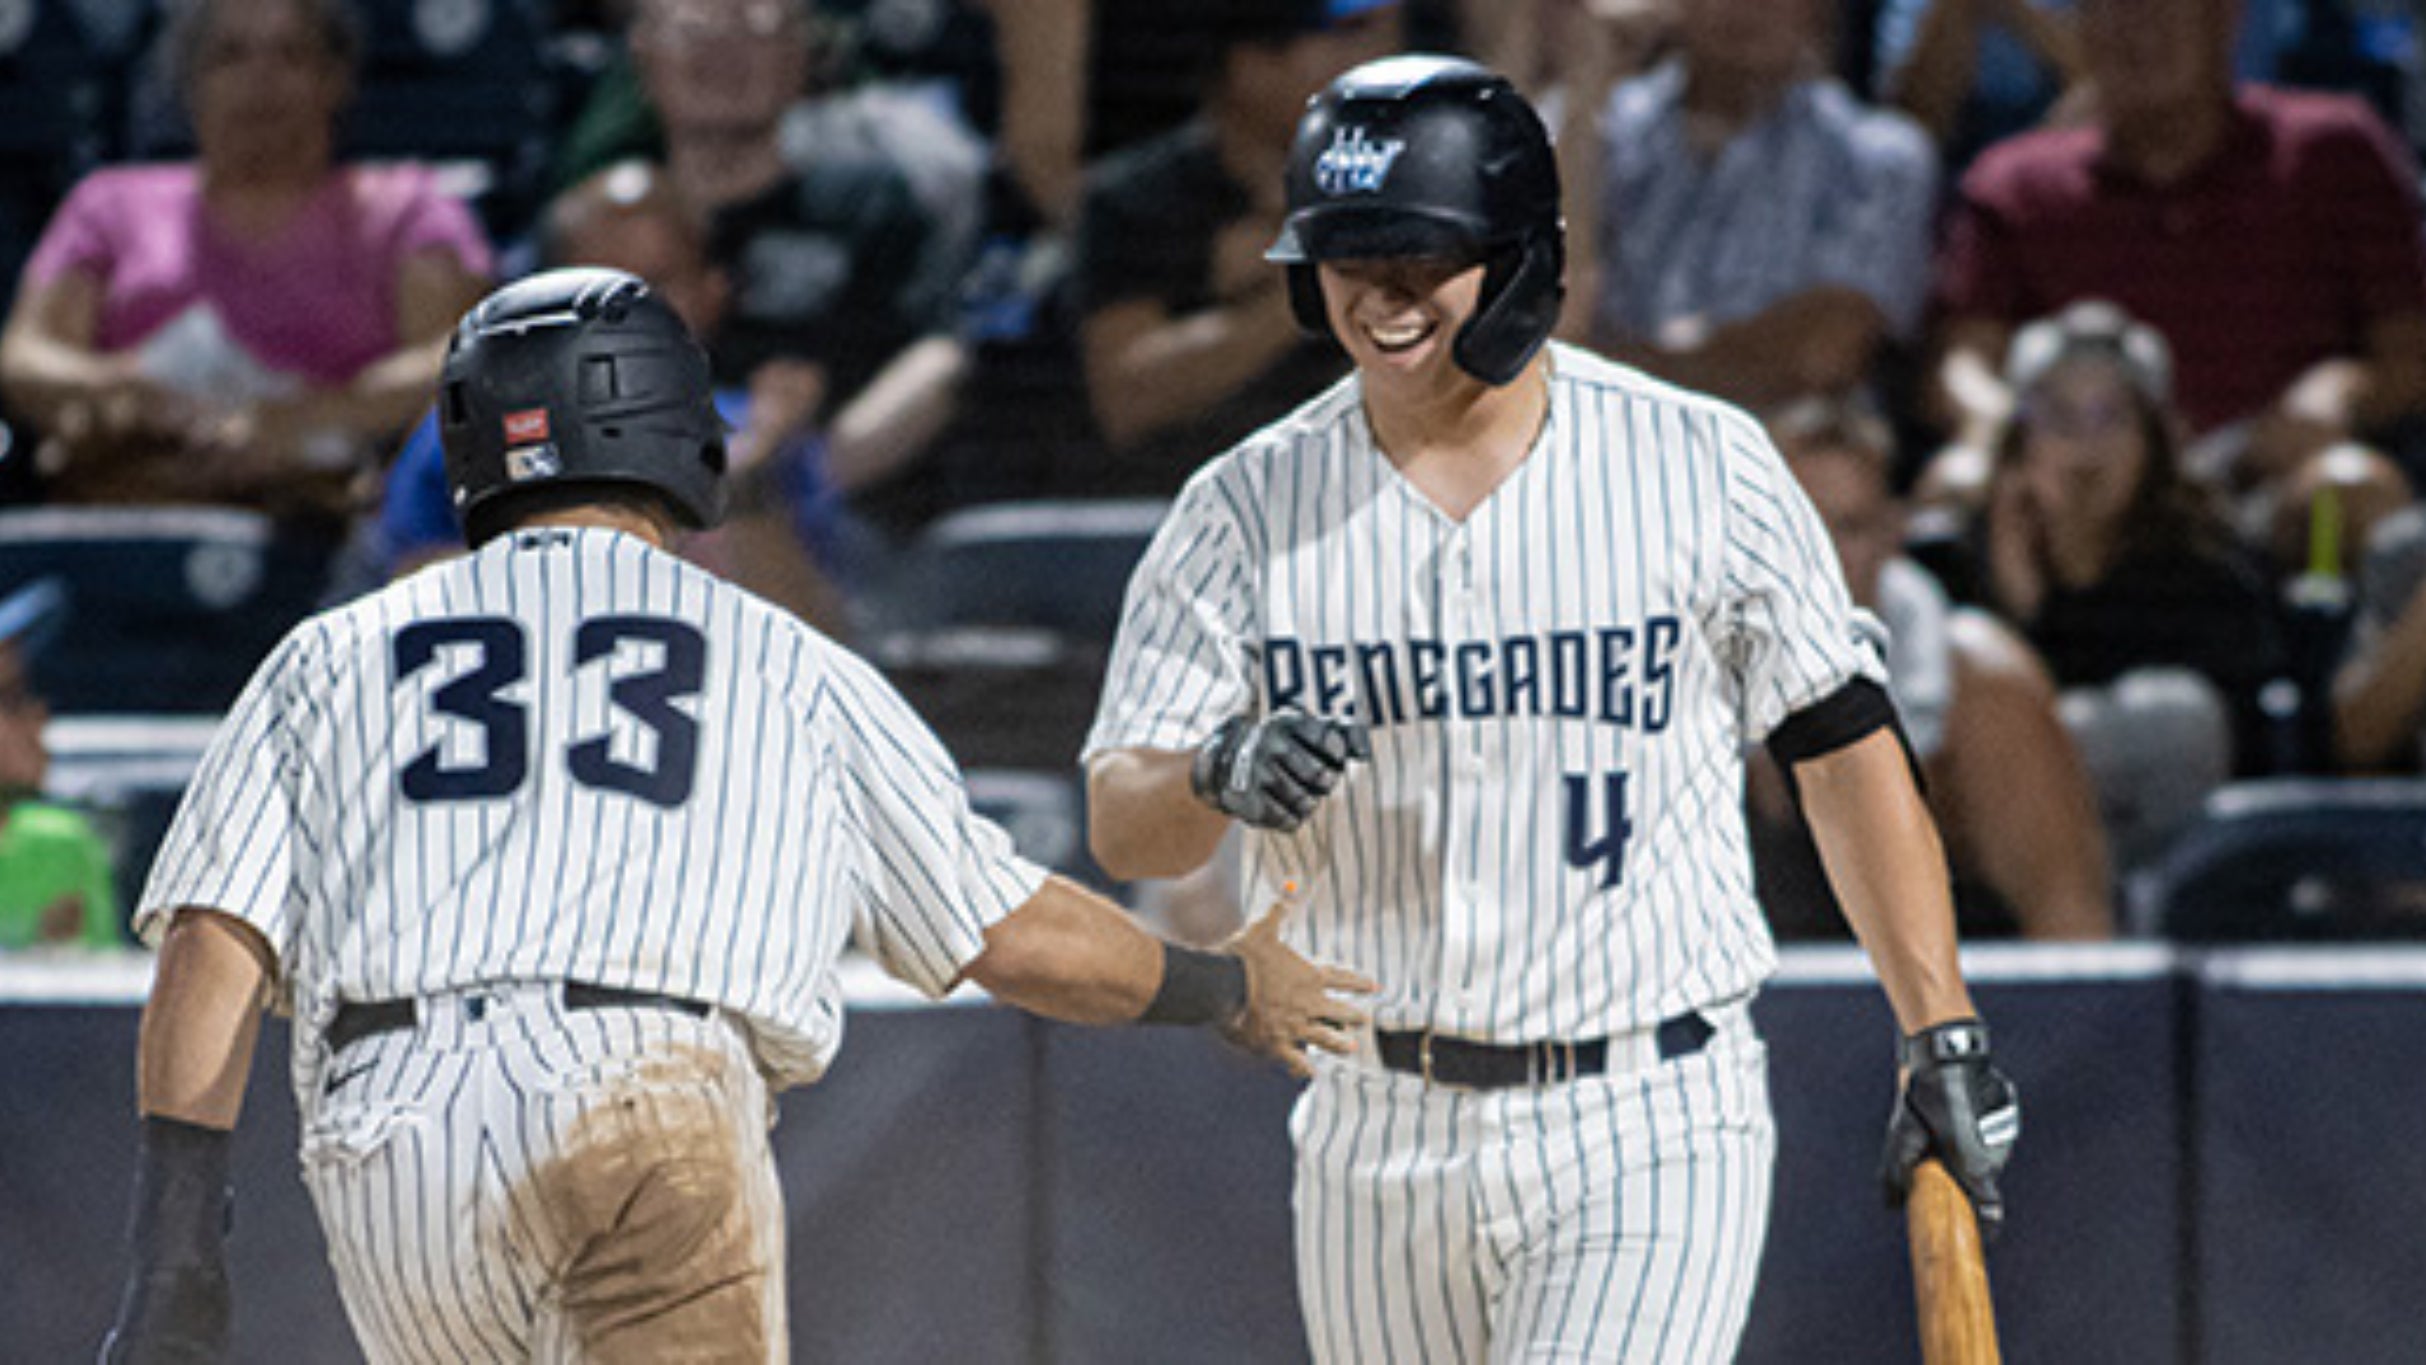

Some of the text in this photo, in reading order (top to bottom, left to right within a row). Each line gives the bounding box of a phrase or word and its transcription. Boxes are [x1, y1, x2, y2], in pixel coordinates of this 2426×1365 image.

[394, 616, 705, 809] 33
[1264, 616, 1680, 733] RENEGADES
[1562, 772, 1632, 889] 4
